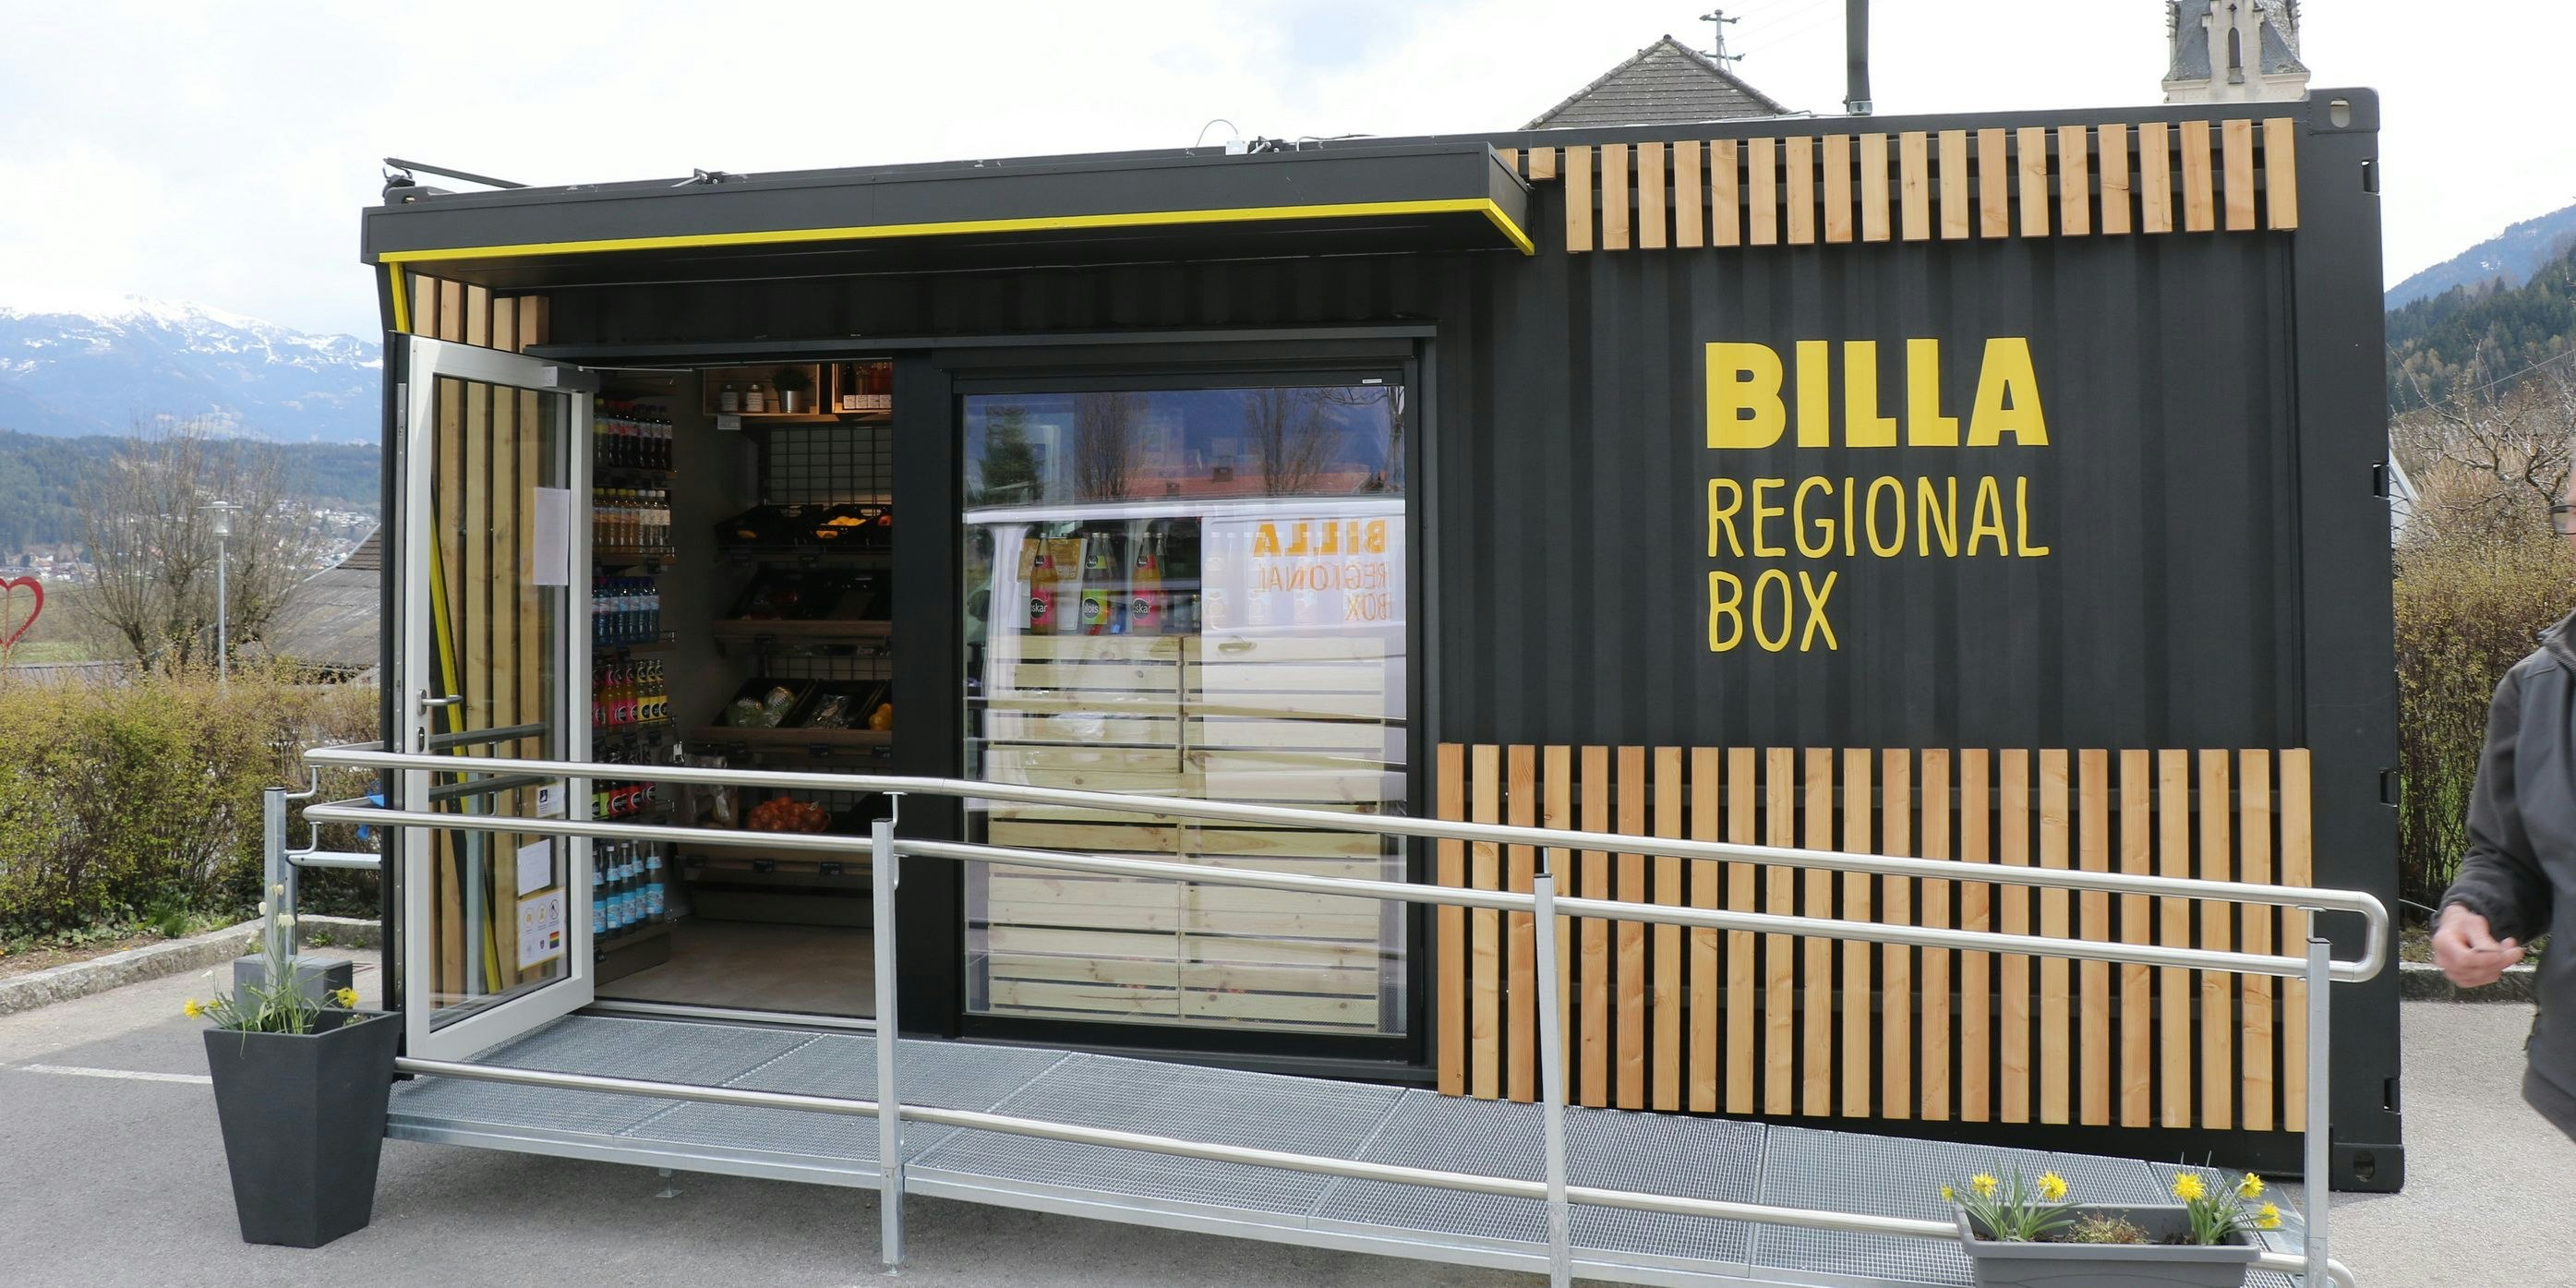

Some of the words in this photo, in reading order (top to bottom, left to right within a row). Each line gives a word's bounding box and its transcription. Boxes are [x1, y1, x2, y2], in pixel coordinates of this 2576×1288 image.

[1705, 337, 2050, 450] BILLA
[1707, 475, 2051, 559] REGIONAL
[1030, 602, 1048, 613] skar
[1708, 568, 1838, 653] BOX
